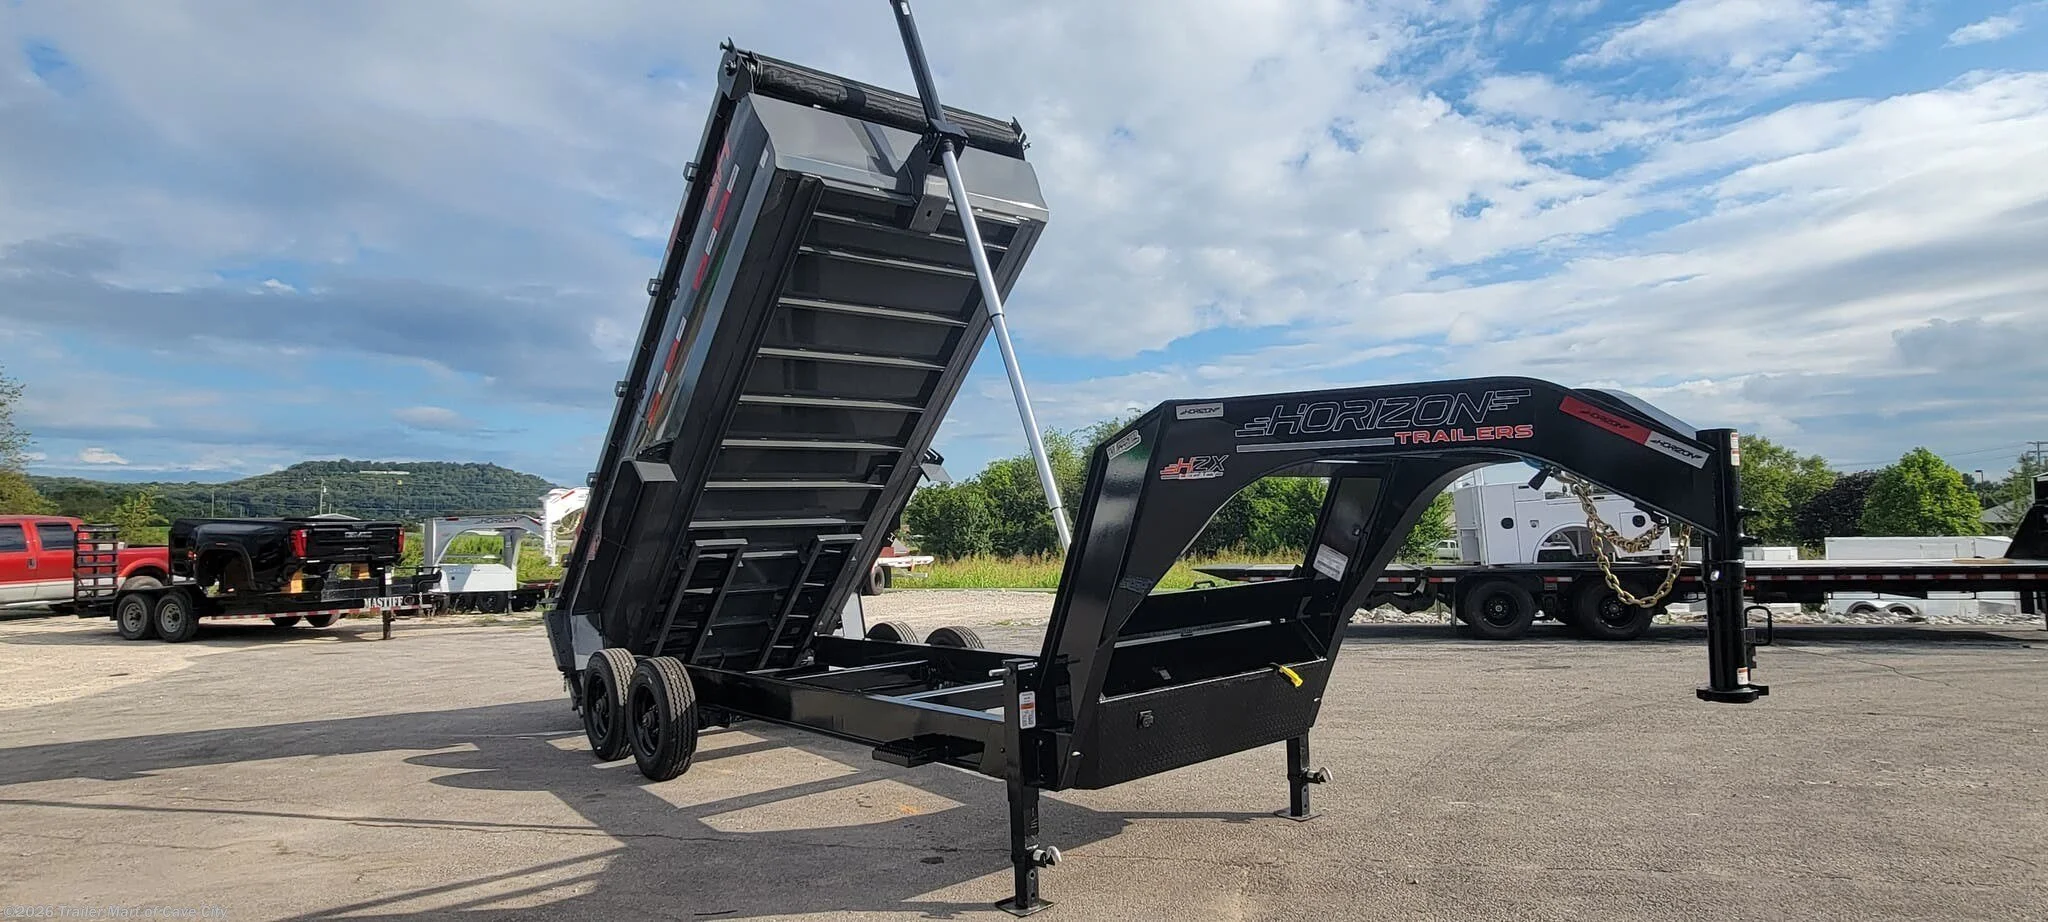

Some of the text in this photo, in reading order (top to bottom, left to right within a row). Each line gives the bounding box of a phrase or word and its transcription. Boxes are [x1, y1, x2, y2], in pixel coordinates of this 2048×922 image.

[1264, 390, 1496, 437] HORIZON
[1395, 425, 1534, 445] TRAILERS
[1650, 439, 1704, 460] HORIZON
[363, 596, 404, 609] MASTIFF
